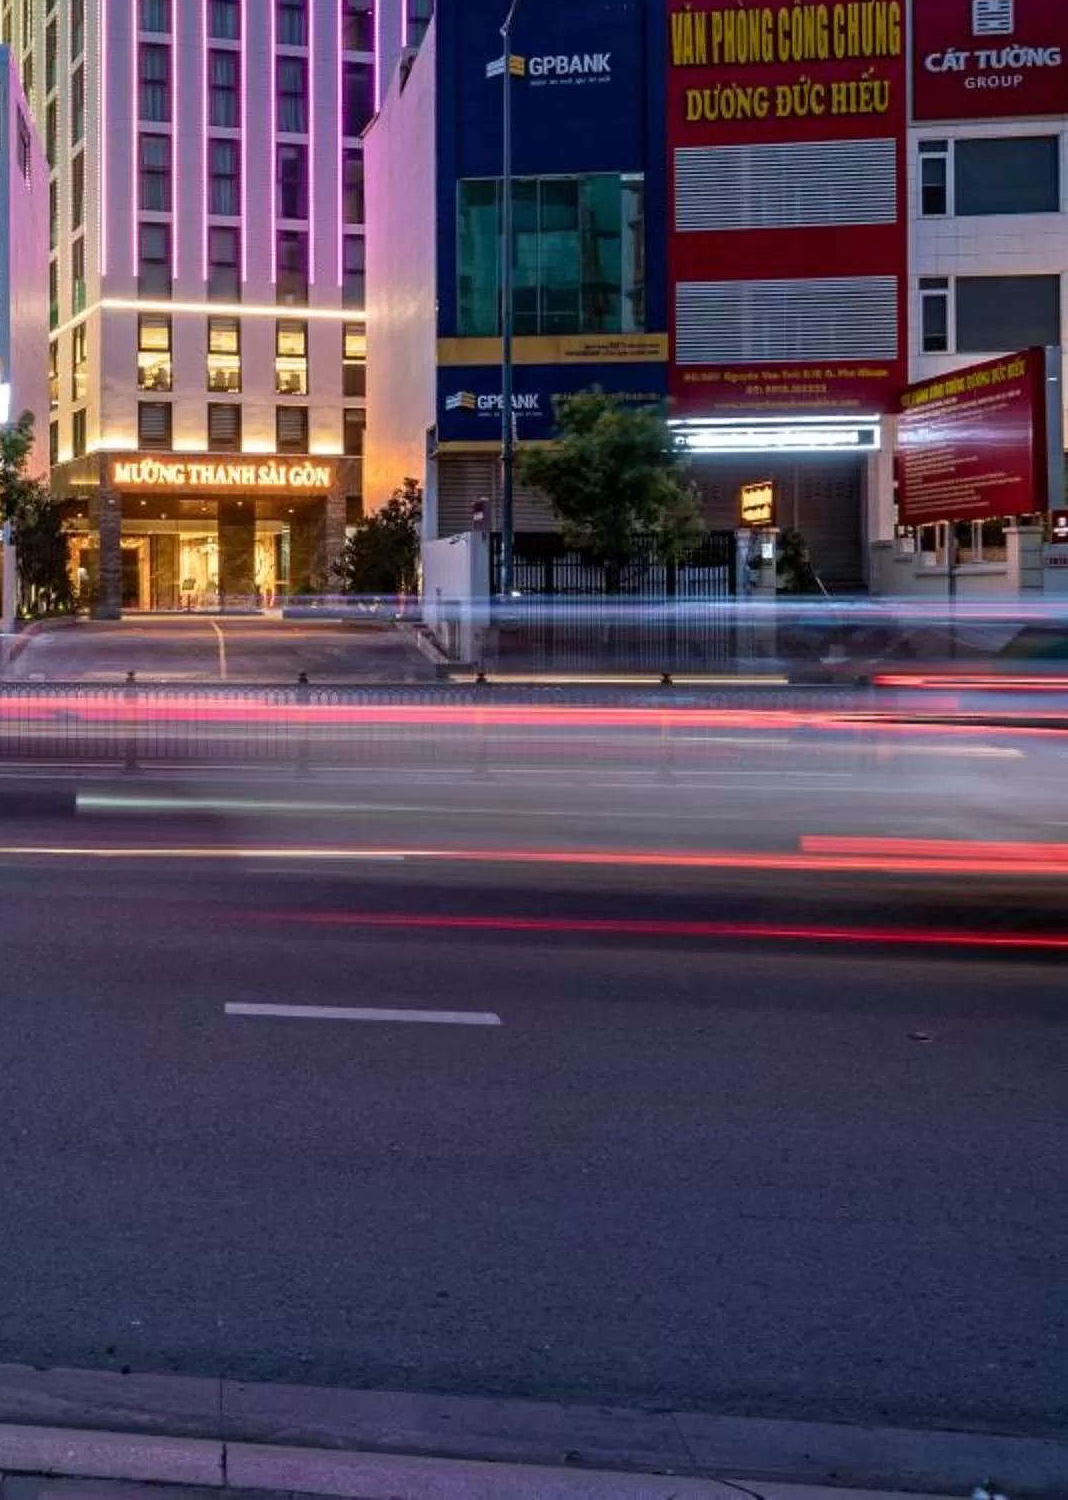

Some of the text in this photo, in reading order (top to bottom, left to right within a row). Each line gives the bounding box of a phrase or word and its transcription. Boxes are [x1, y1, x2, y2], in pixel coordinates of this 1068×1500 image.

[671, 3, 707, 66] VĂN
[711, 0, 774, 64] PHÒNG
[529, 52, 611, 76] GPBANK
[924, 44, 1061, 72] CÁT TƯỜNG
[686, 65, 891, 121] DƯƠNG ĐỨC HIẾU
[964, 73, 1023, 89] GROUP
[113, 456, 331, 488] MƯỜNG THANH SÀI GÒN
